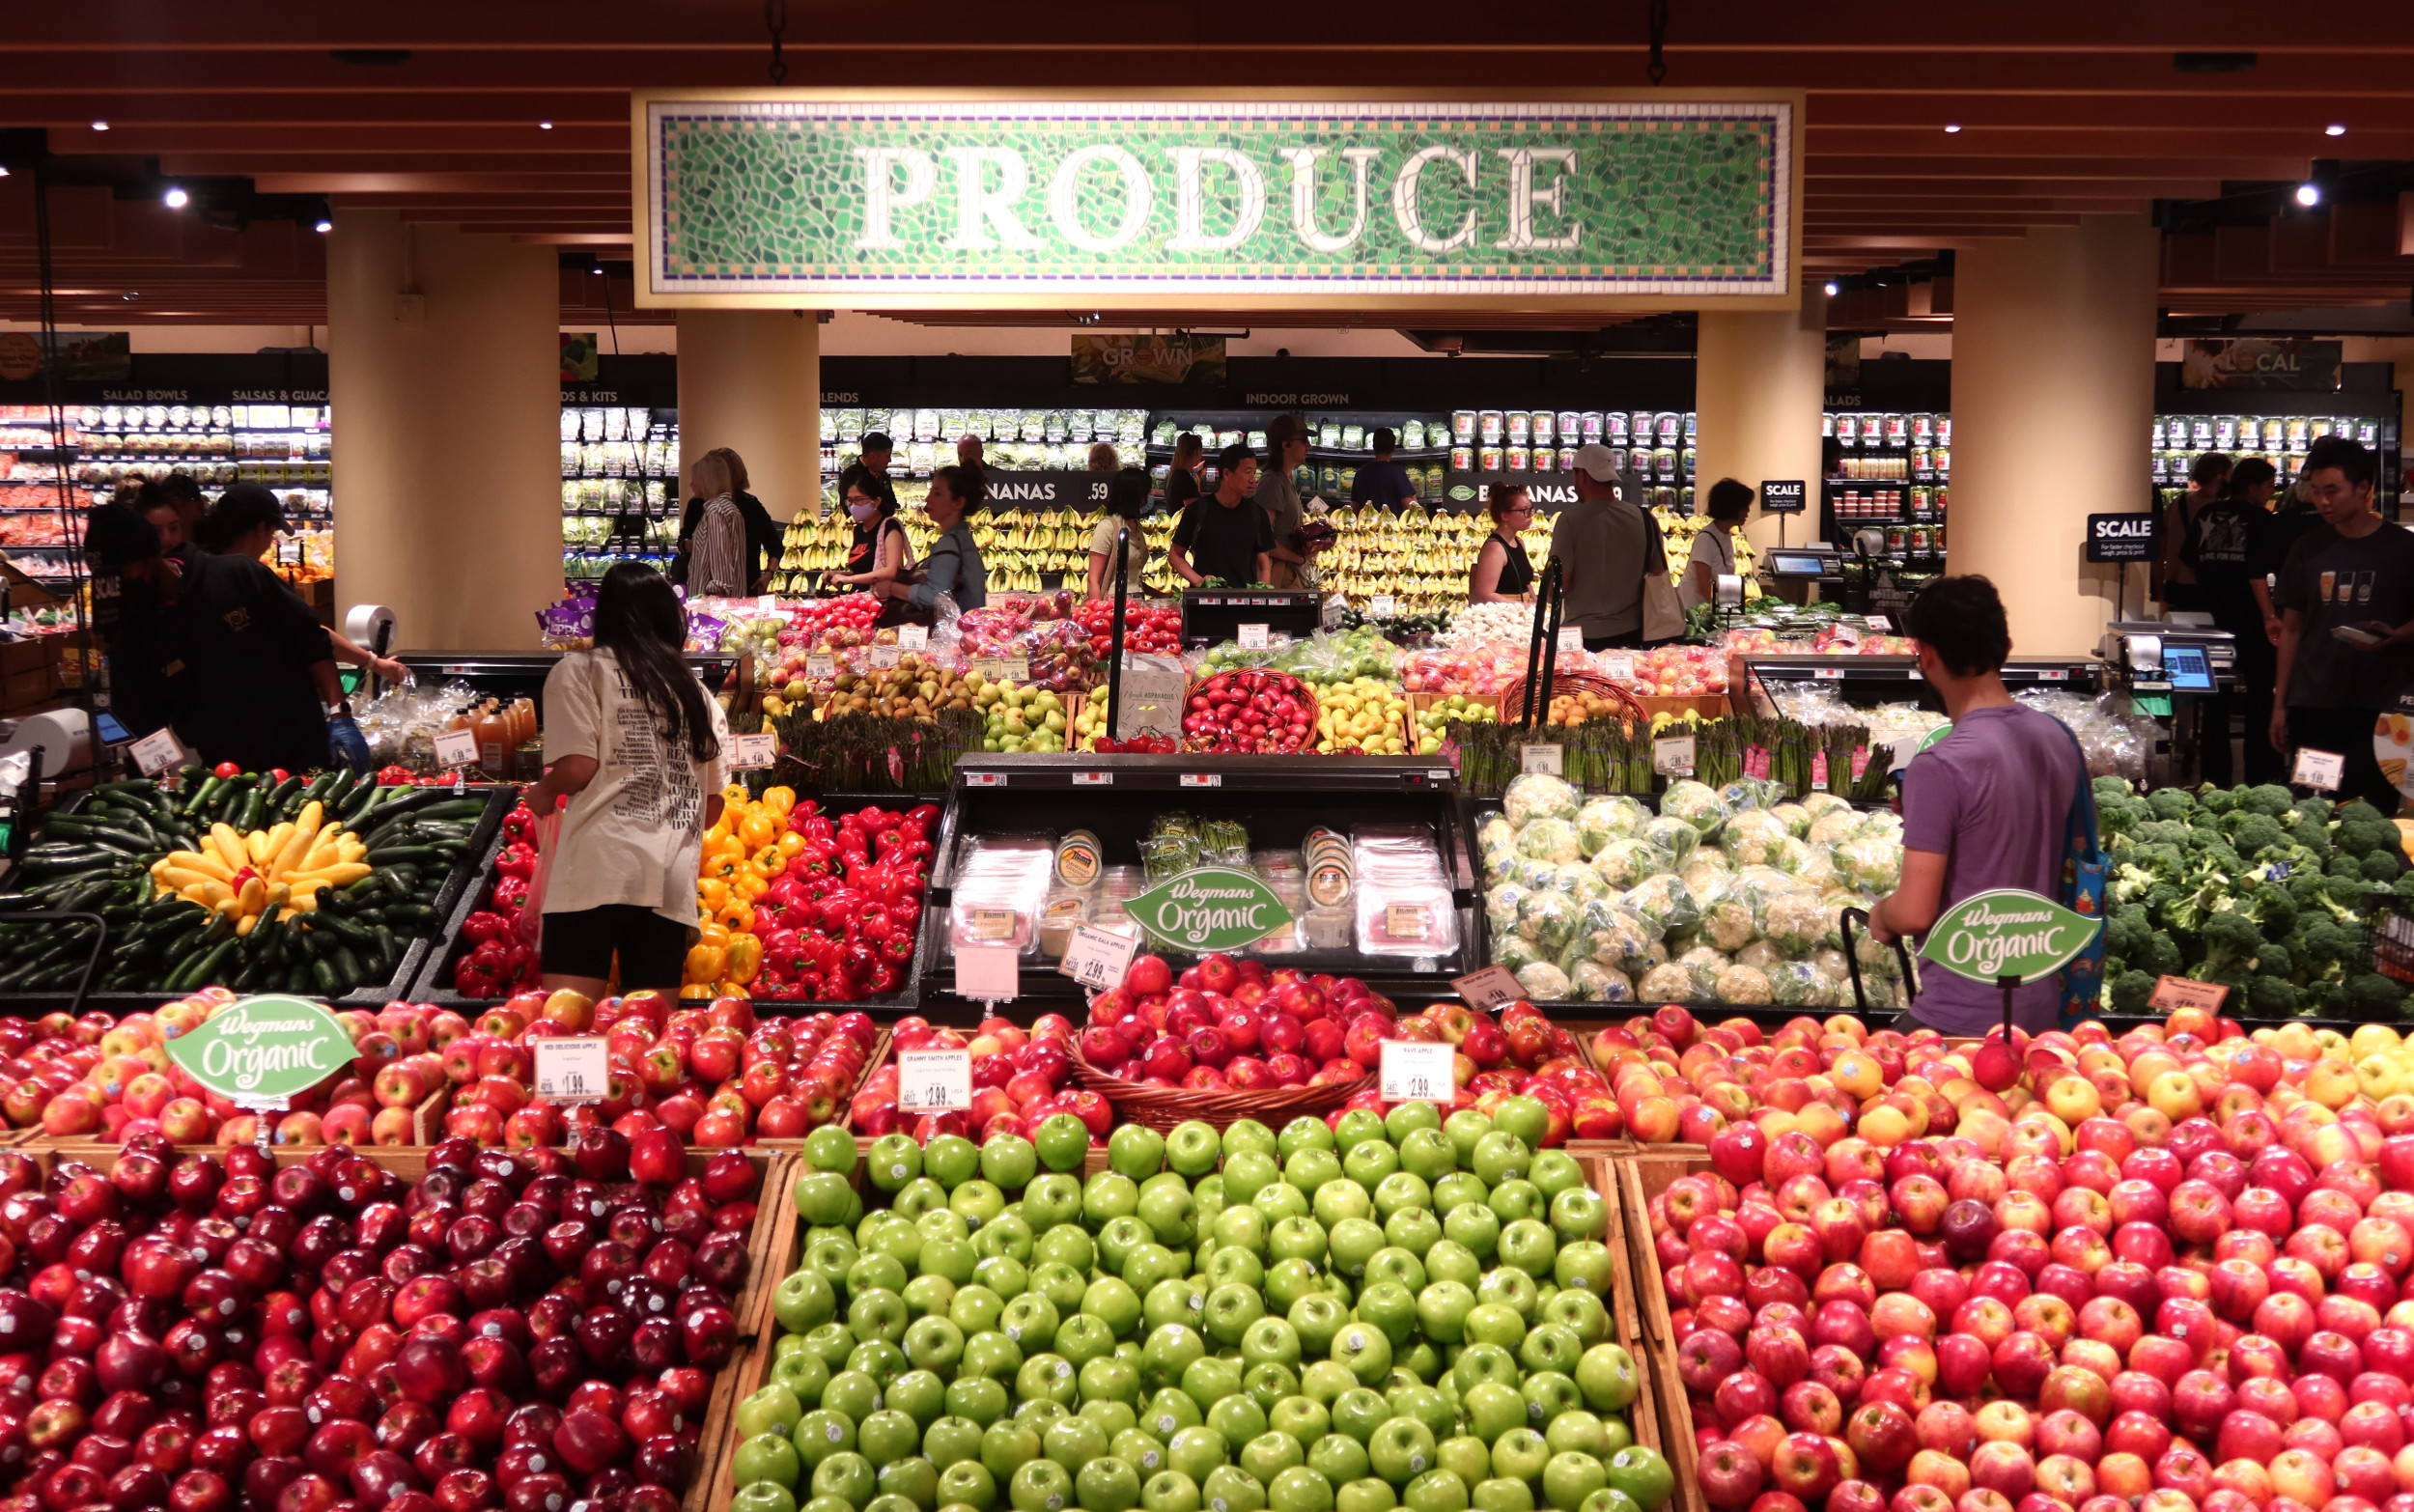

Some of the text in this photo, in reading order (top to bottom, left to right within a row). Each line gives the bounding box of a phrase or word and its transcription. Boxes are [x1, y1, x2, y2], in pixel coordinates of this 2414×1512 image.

[854, 144, 1583, 252] PRODUCE
[102, 390, 188, 401] SALAD BOWLS
[232, 390, 275, 401] SALSAS
[280, 390, 289, 401] &
[579, 391, 588, 402] &
[592, 391, 617, 402] KITS
[820, 392, 859, 403] LENDS
[1246, 393, 1349, 405] INDOOR GROWN
[1087, 483, 1109, 500] .59
[1478, 485, 1579, 503] BANAS
[1766, 485, 1801, 495] SCALE
[2095, 520, 2151, 537] SCALE
[1144, 691, 1174, 700] ASPARAGUS
[1168, 878, 1255, 908] Wegmans
[1157, 901, 1267, 943] Organic
[1960, 903, 2054, 935] Wegmans
[1078, 931, 1126, 950] ORGANIC GALA APPLES
[1947, 926, 2065, 975] Organic
[216, 1009, 316, 1045] Wegmans
[202, 1036, 329, 1090] Organic
